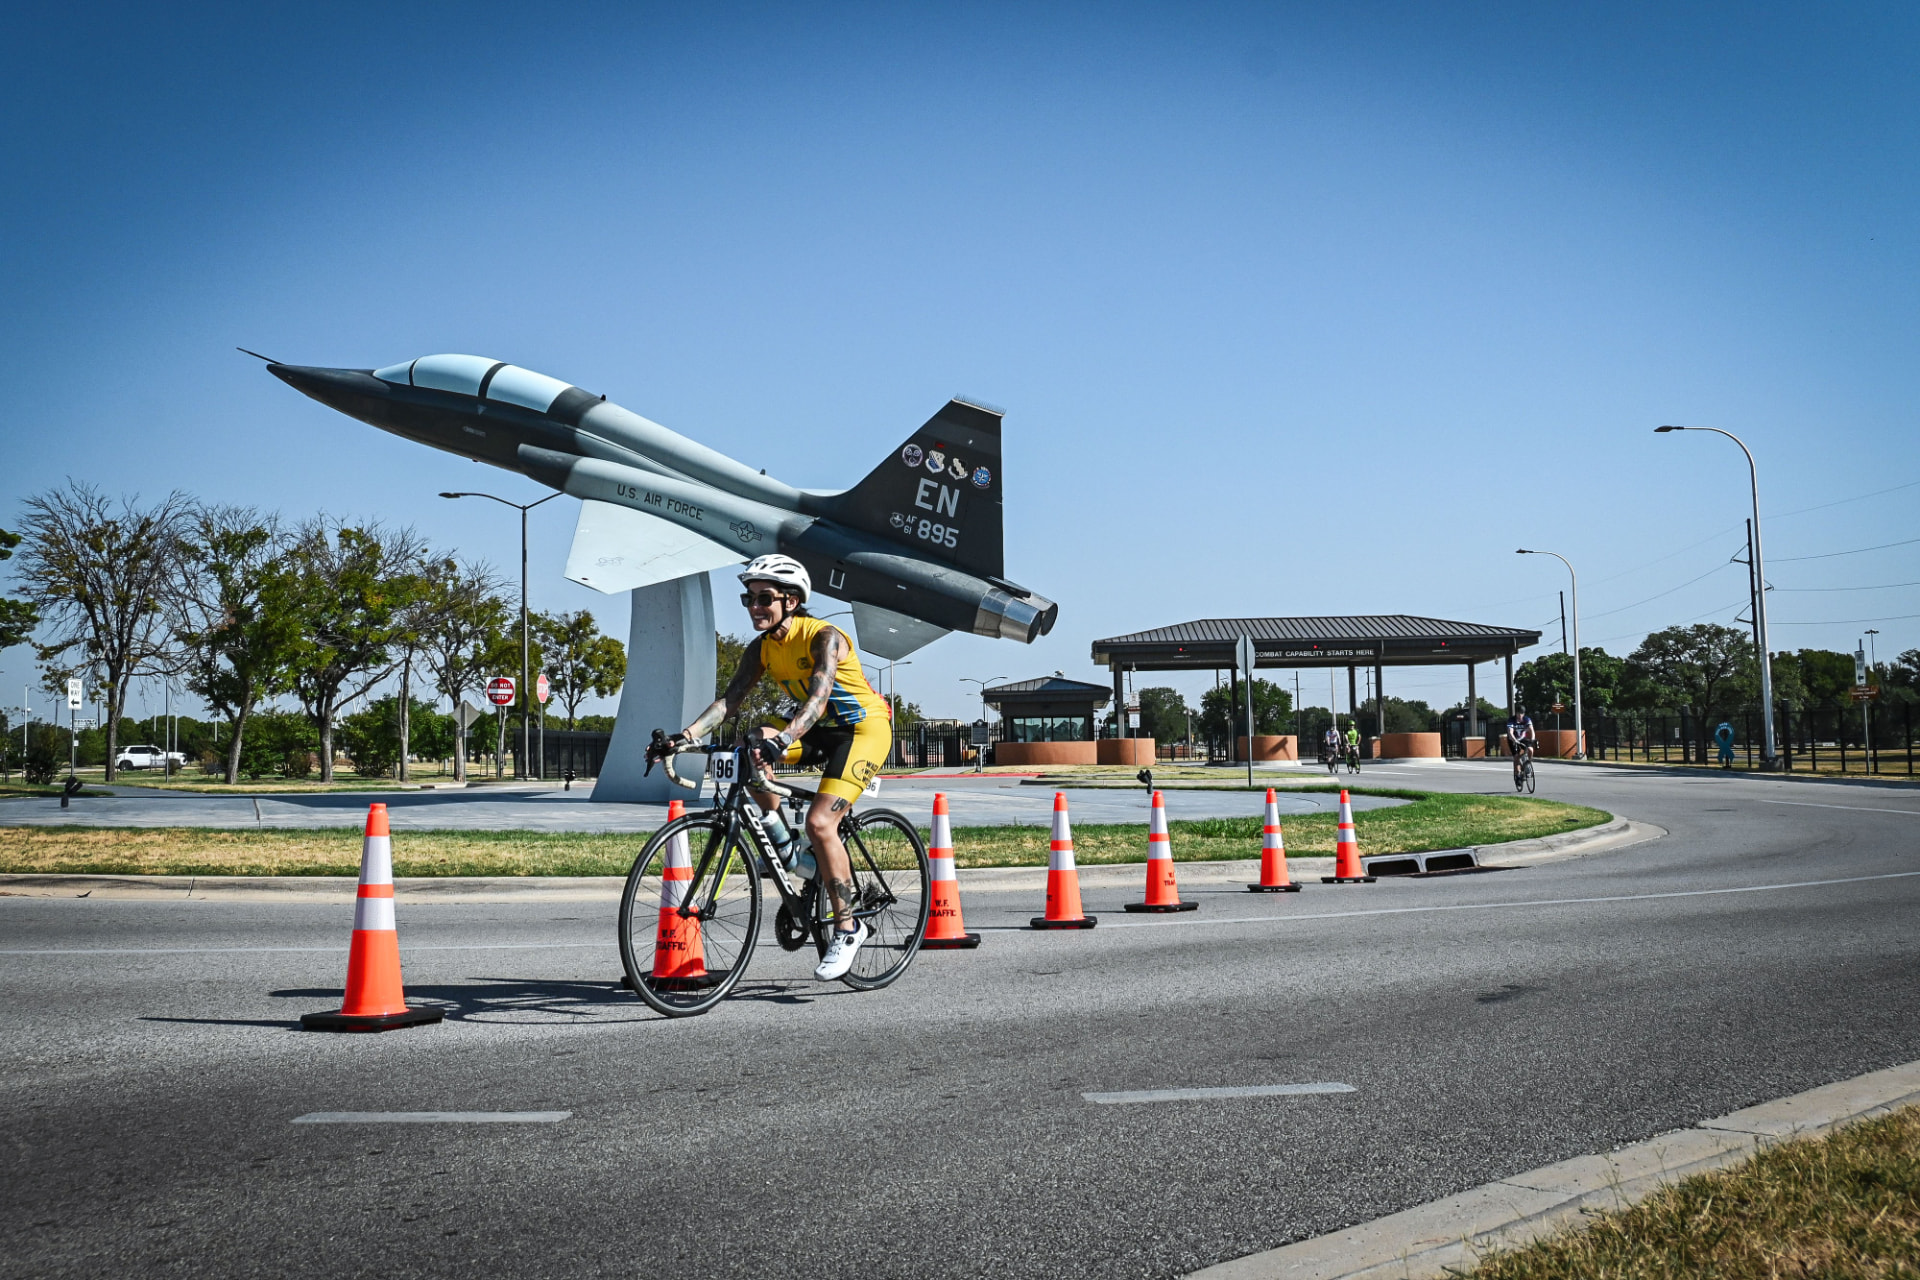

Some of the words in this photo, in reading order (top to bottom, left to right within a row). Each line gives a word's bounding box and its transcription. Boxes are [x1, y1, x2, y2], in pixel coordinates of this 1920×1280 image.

[616, 484, 639, 501] U.S.
[643, 491, 663, 507] AIR
[666, 498, 704, 521] FORCE
[914, 477, 960, 518] EN
[905, 514, 918, 524] AF
[917, 519, 960, 548] 895
[70, 681, 80, 689] ONE
[934, 899, 949, 907] W.F.
